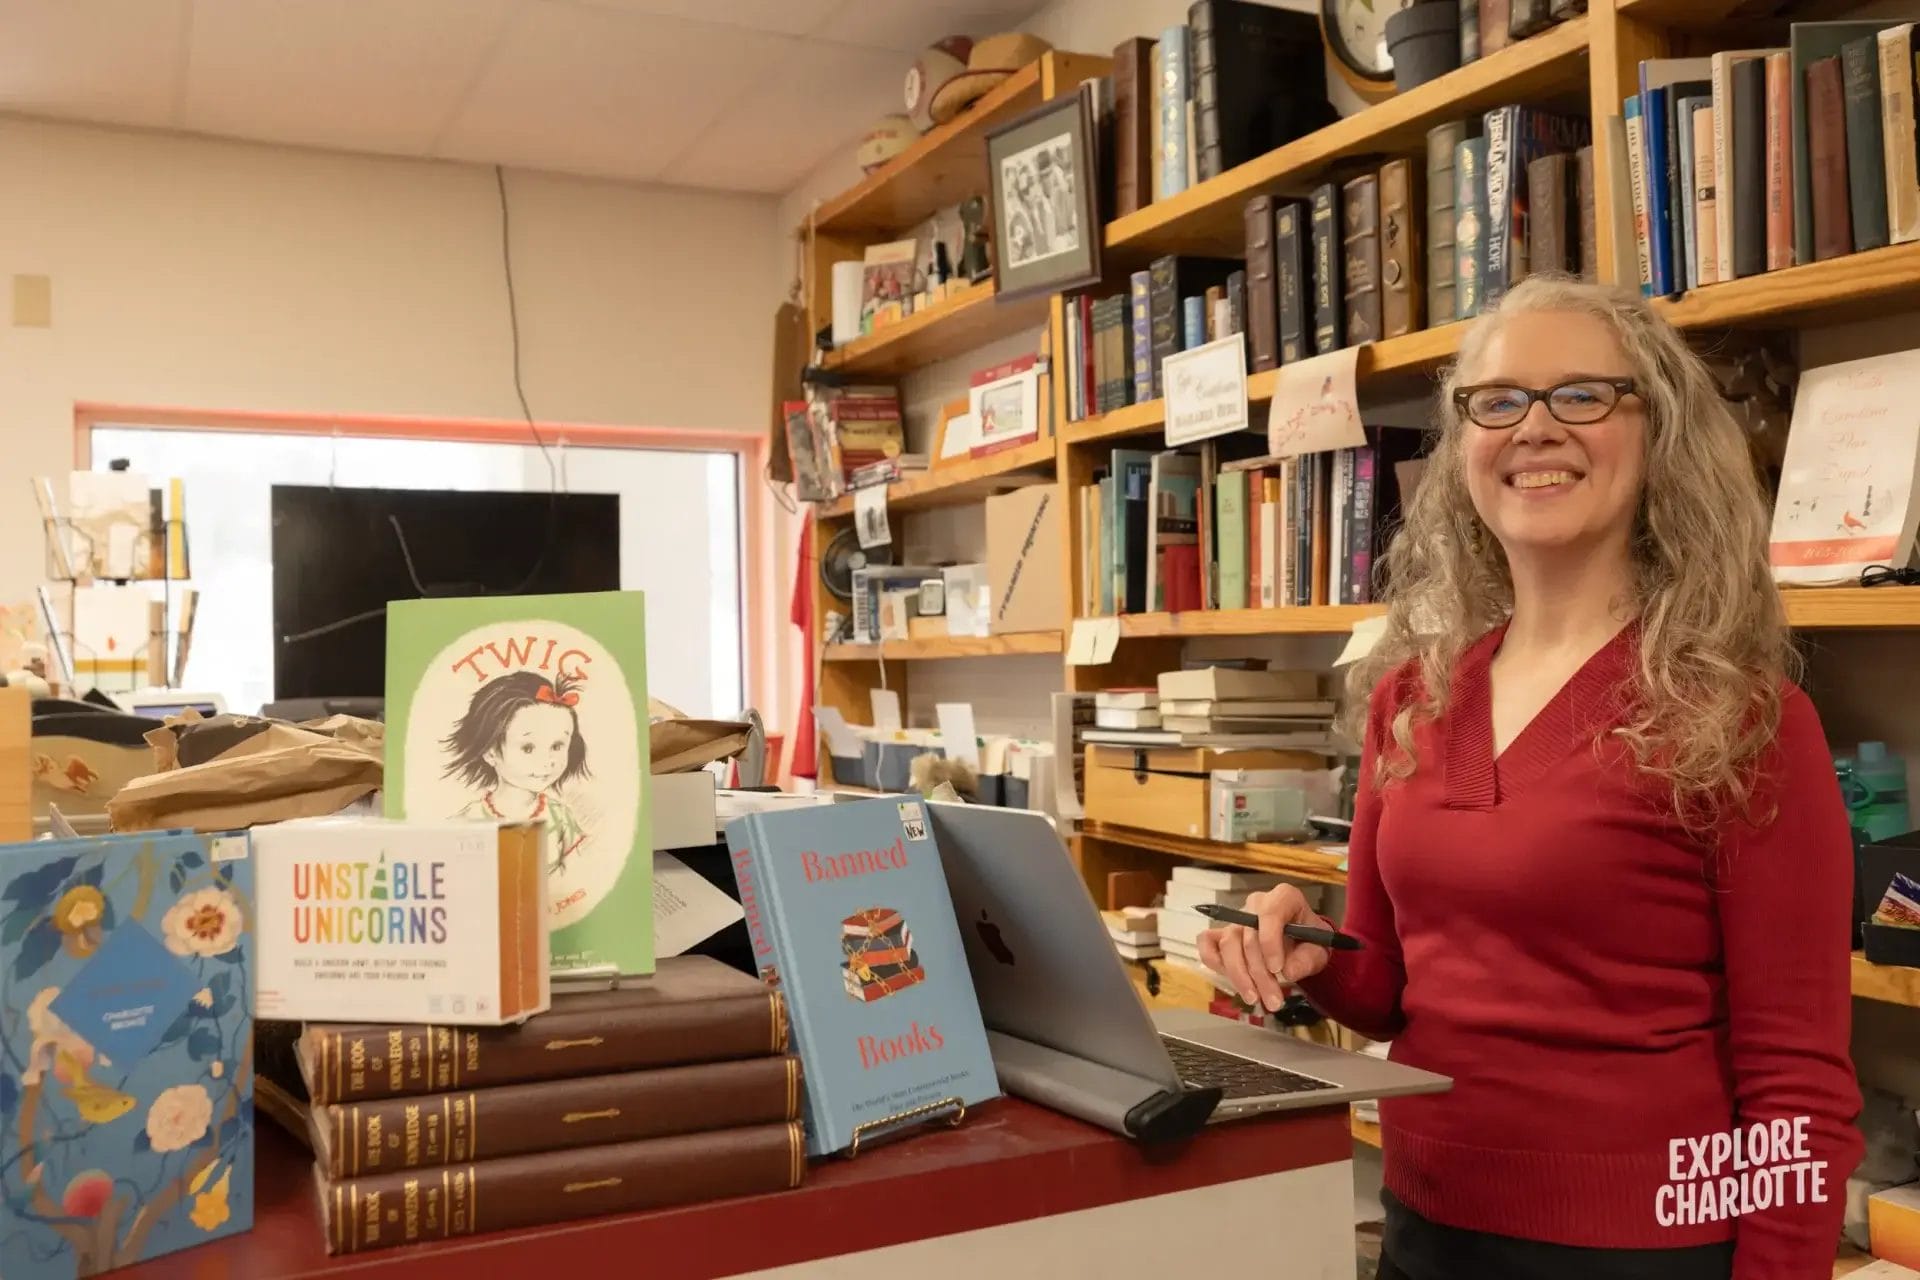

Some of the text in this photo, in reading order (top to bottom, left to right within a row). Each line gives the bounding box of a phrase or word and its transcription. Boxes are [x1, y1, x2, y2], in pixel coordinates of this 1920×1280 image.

[1488, 237, 1501, 272] HOPE
[452, 636, 592, 682] TWIG
[905, 822, 925, 839] NEW
[294, 850, 446, 900] UNSTABLE
[801, 836, 908, 885] Banned
[294, 906, 447, 944] UNICORNS
[735, 848, 773, 956] Banned
[351, 1038, 365, 1091] THE BOOK
[389, 1029, 403, 1090] KNOWLEDGE
[466, 1031, 479, 1071] INDEX
[857, 1020, 944, 1071] Books
[367, 1114, 381, 1148] BOOK
[405, 1104, 419, 1165] KNOWLEDGE
[366, 1190, 380, 1222] BOOK
[404, 1178, 418, 1239] KNOWLEDGE
